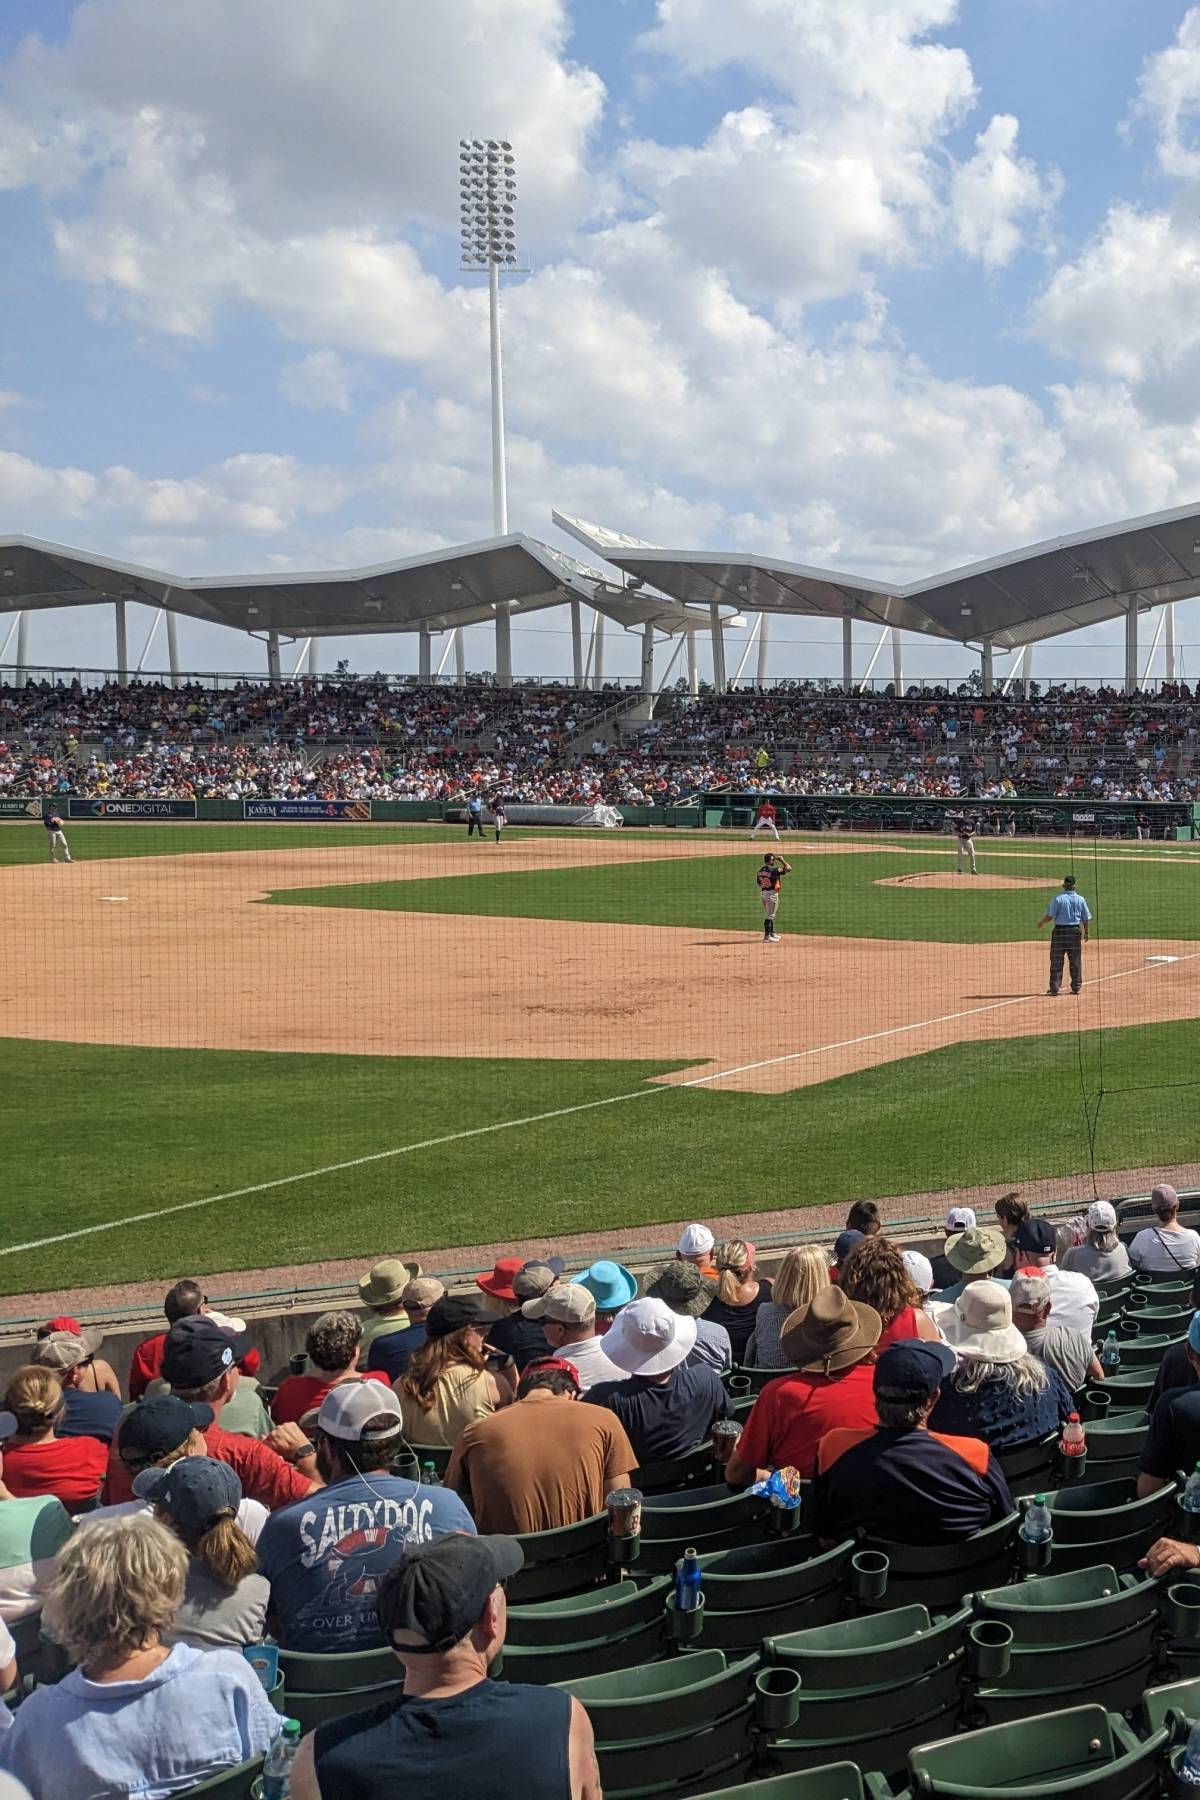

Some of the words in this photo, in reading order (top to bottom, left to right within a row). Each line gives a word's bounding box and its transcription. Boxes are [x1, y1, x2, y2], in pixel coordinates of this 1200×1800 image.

[106, 802, 175, 814] ONEDIGITAL
[247, 806, 277, 817] KAYEM
[312, 1614, 353, 1629] OVER
